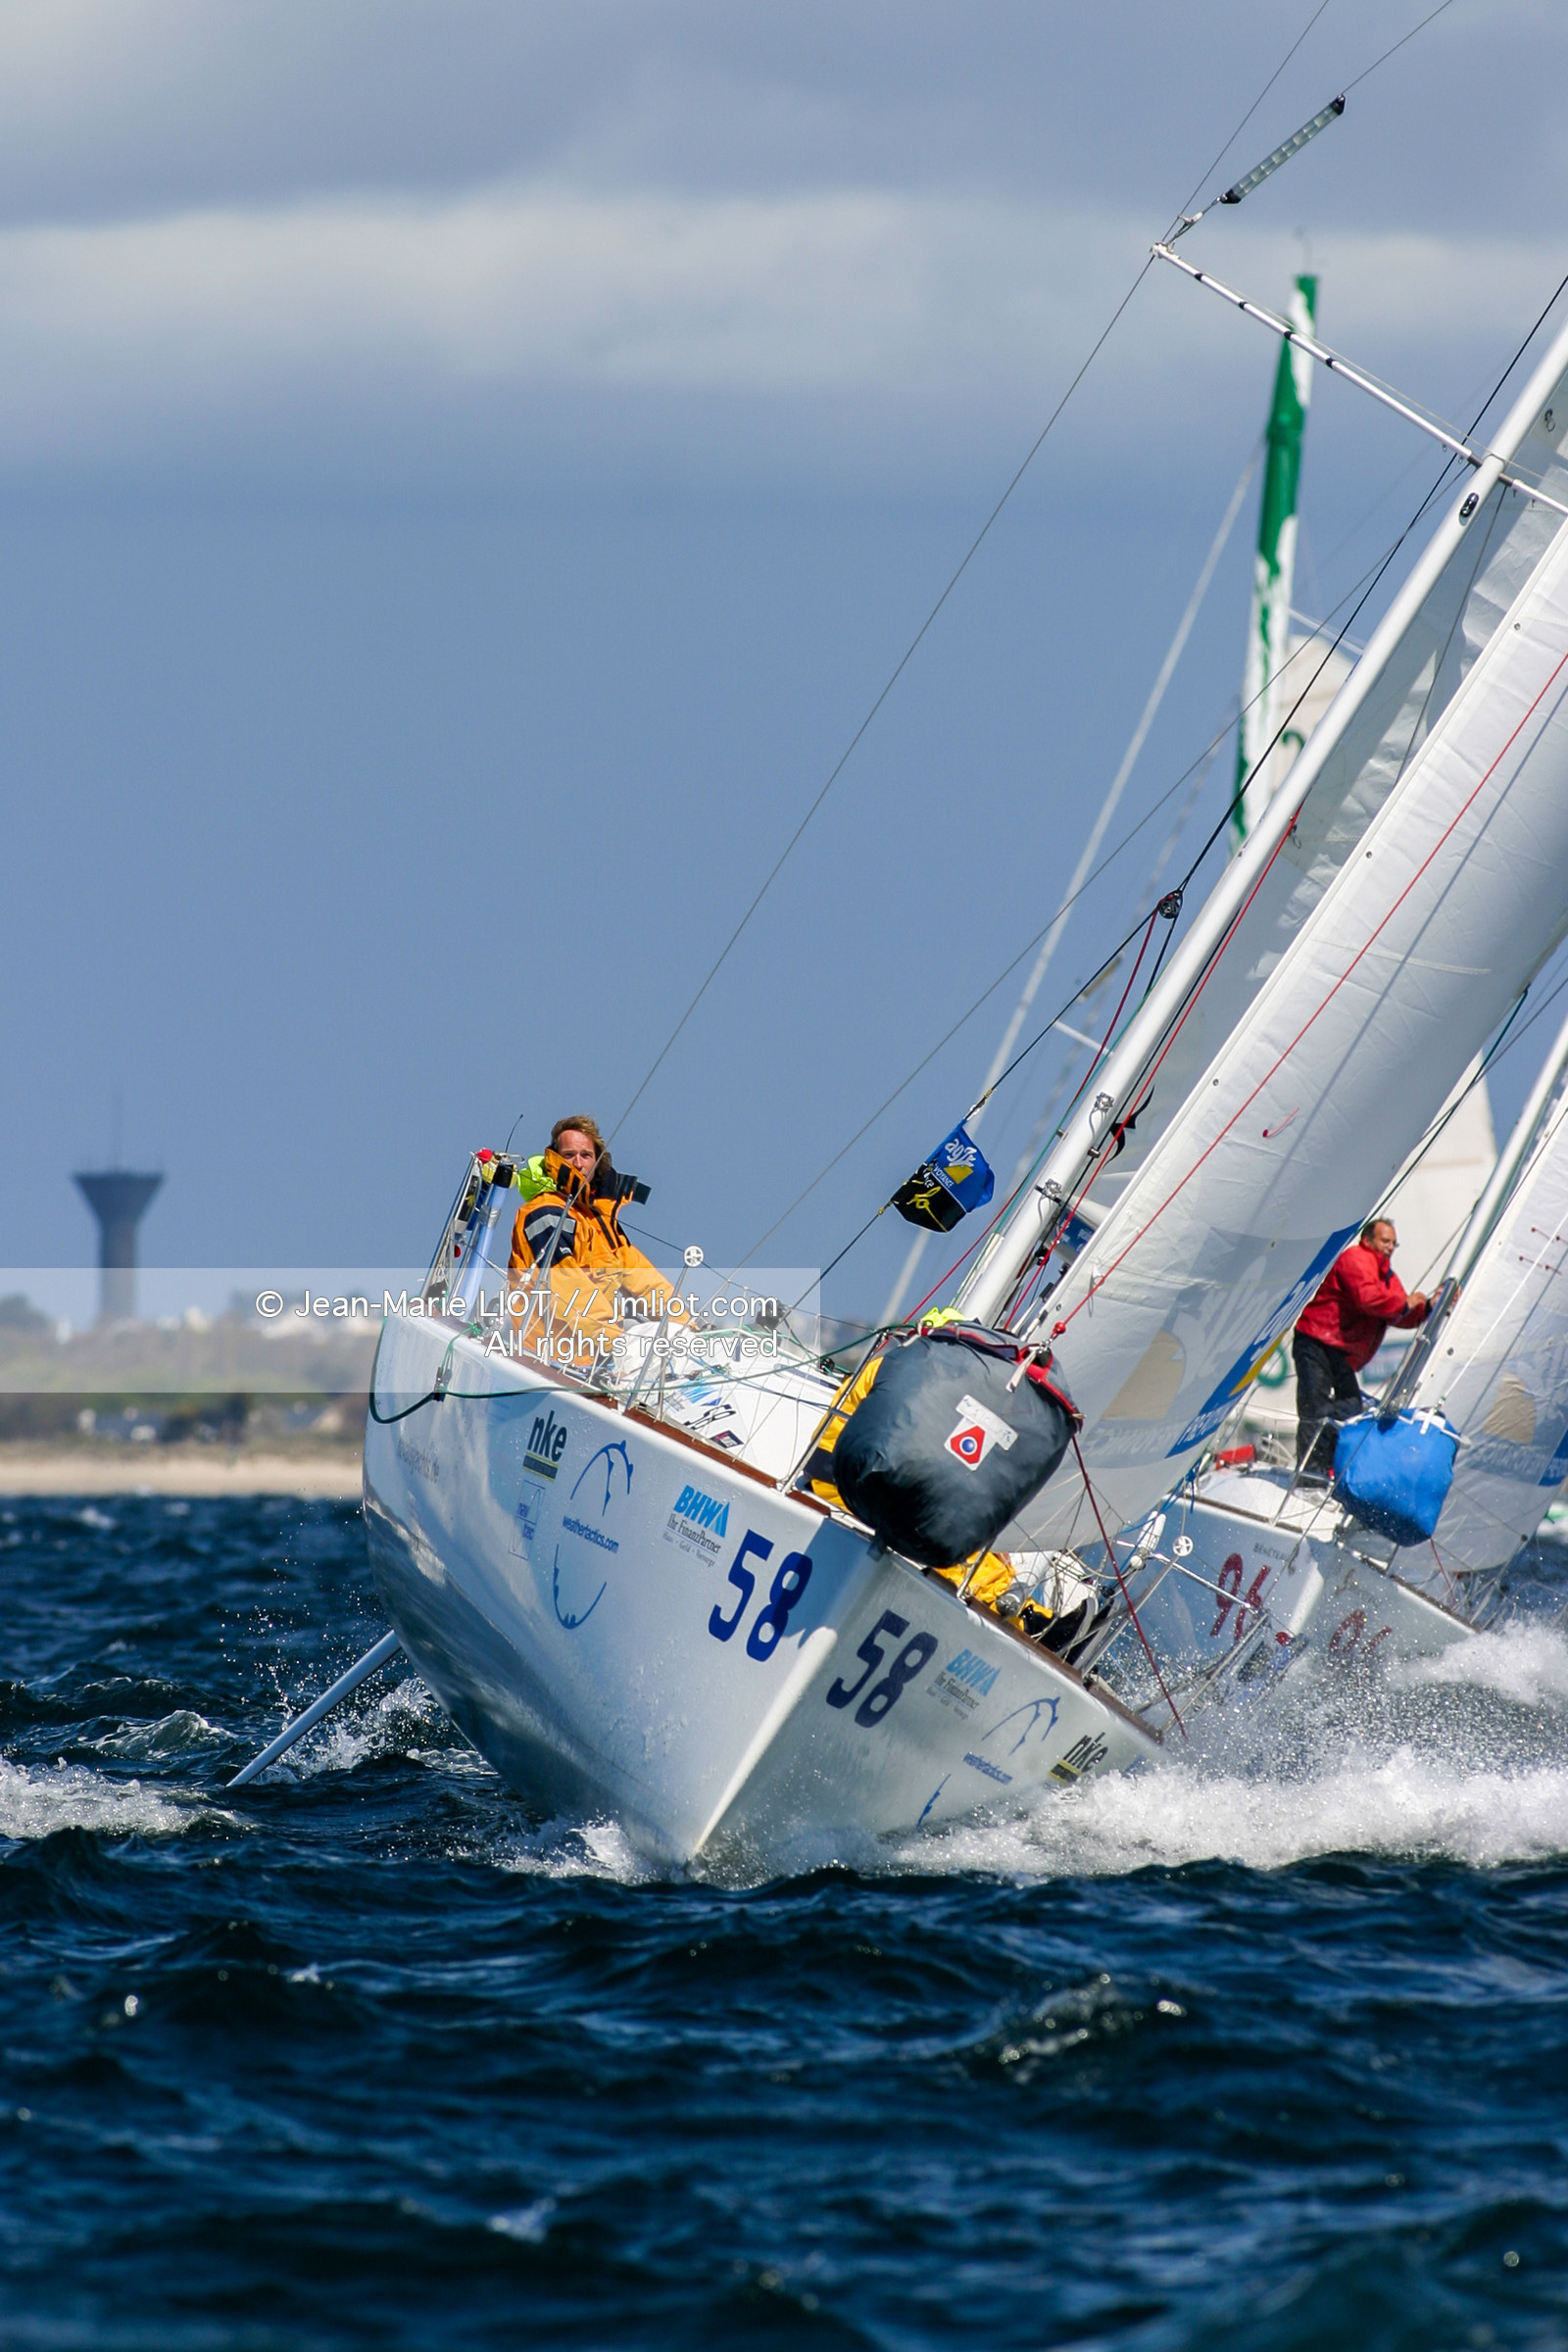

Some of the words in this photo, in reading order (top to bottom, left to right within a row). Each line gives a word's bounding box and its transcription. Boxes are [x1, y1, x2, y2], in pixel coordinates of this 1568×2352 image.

[527, 1410, 567, 1462] nke
[673, 1485, 724, 1529] BHW
[708, 1529, 813, 1662] 58
[826, 1608, 939, 1729] 58
